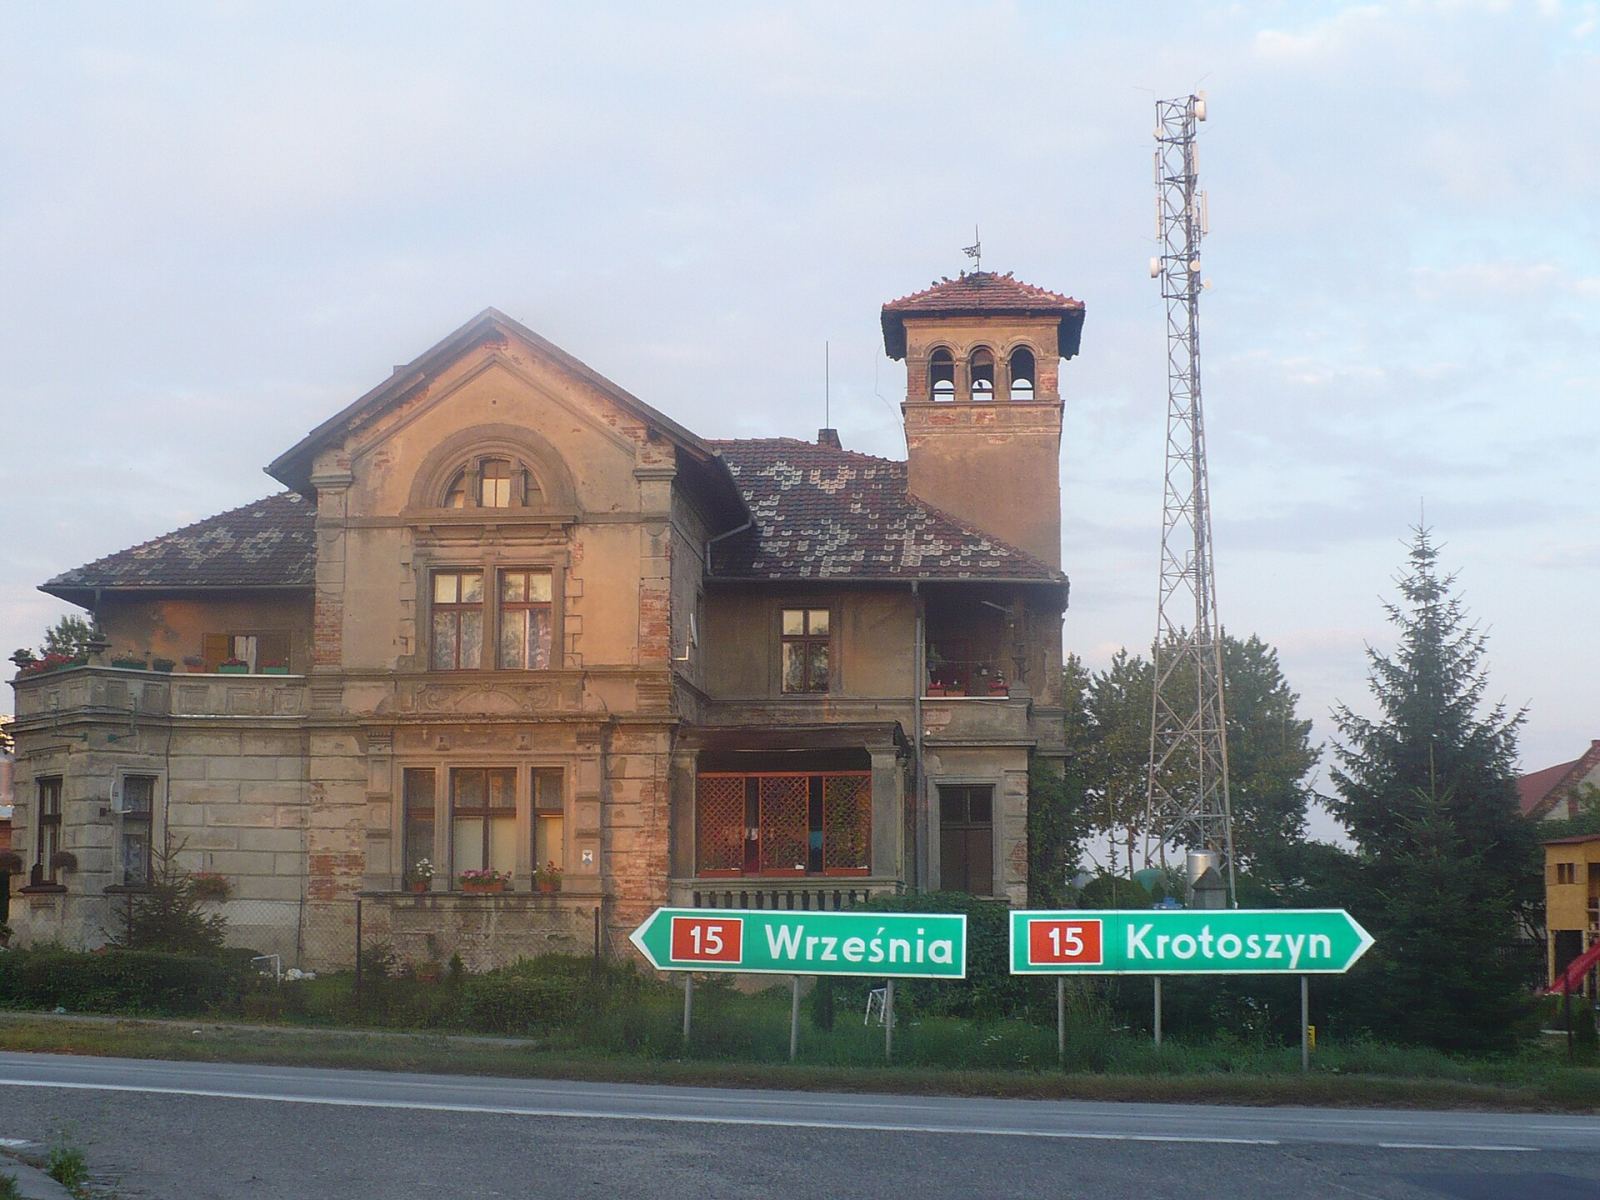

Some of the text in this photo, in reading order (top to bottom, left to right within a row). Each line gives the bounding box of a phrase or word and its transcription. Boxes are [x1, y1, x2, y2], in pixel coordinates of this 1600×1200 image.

[690, 924, 953, 964] 15 Września
[1048, 924, 1332, 969] 15 Krotoszyn
